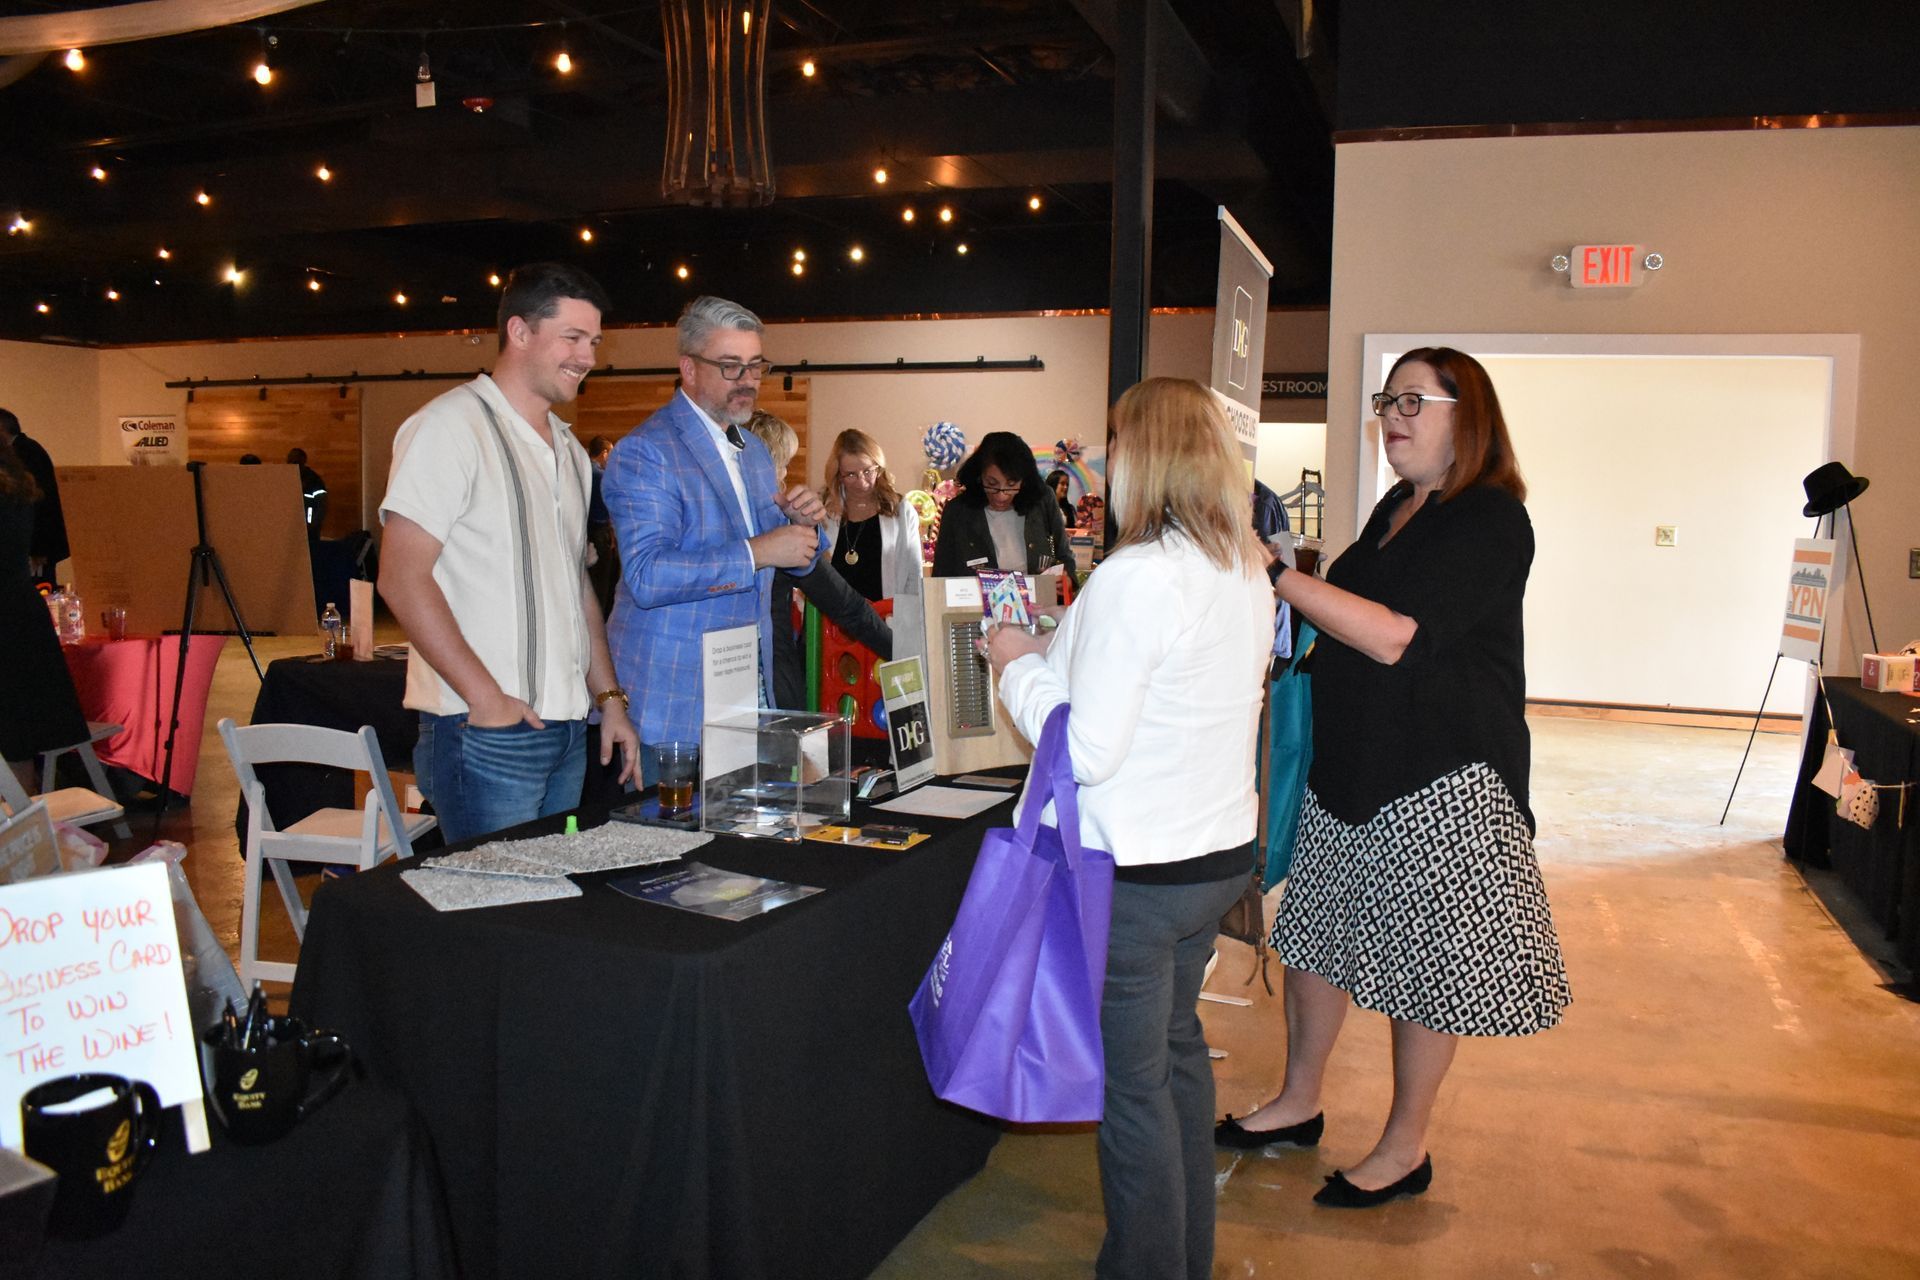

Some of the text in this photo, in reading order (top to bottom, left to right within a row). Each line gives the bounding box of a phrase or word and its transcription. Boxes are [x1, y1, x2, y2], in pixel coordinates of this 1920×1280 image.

[1583, 246, 1635, 284] EXIT
[1262, 380, 1328, 393] ESTROOM
[133, 436, 169, 448] ALLIED
[138, 420, 176, 431] Coleman
[1790, 584, 1825, 618] YPN
[897, 720, 925, 752] DHG
[0, 900, 158, 948] DROP YOUR
[108, 939, 172, 973] CARD
[67, 990, 128, 1020] WIN
[5, 1010, 174, 1075] THE WINE!
